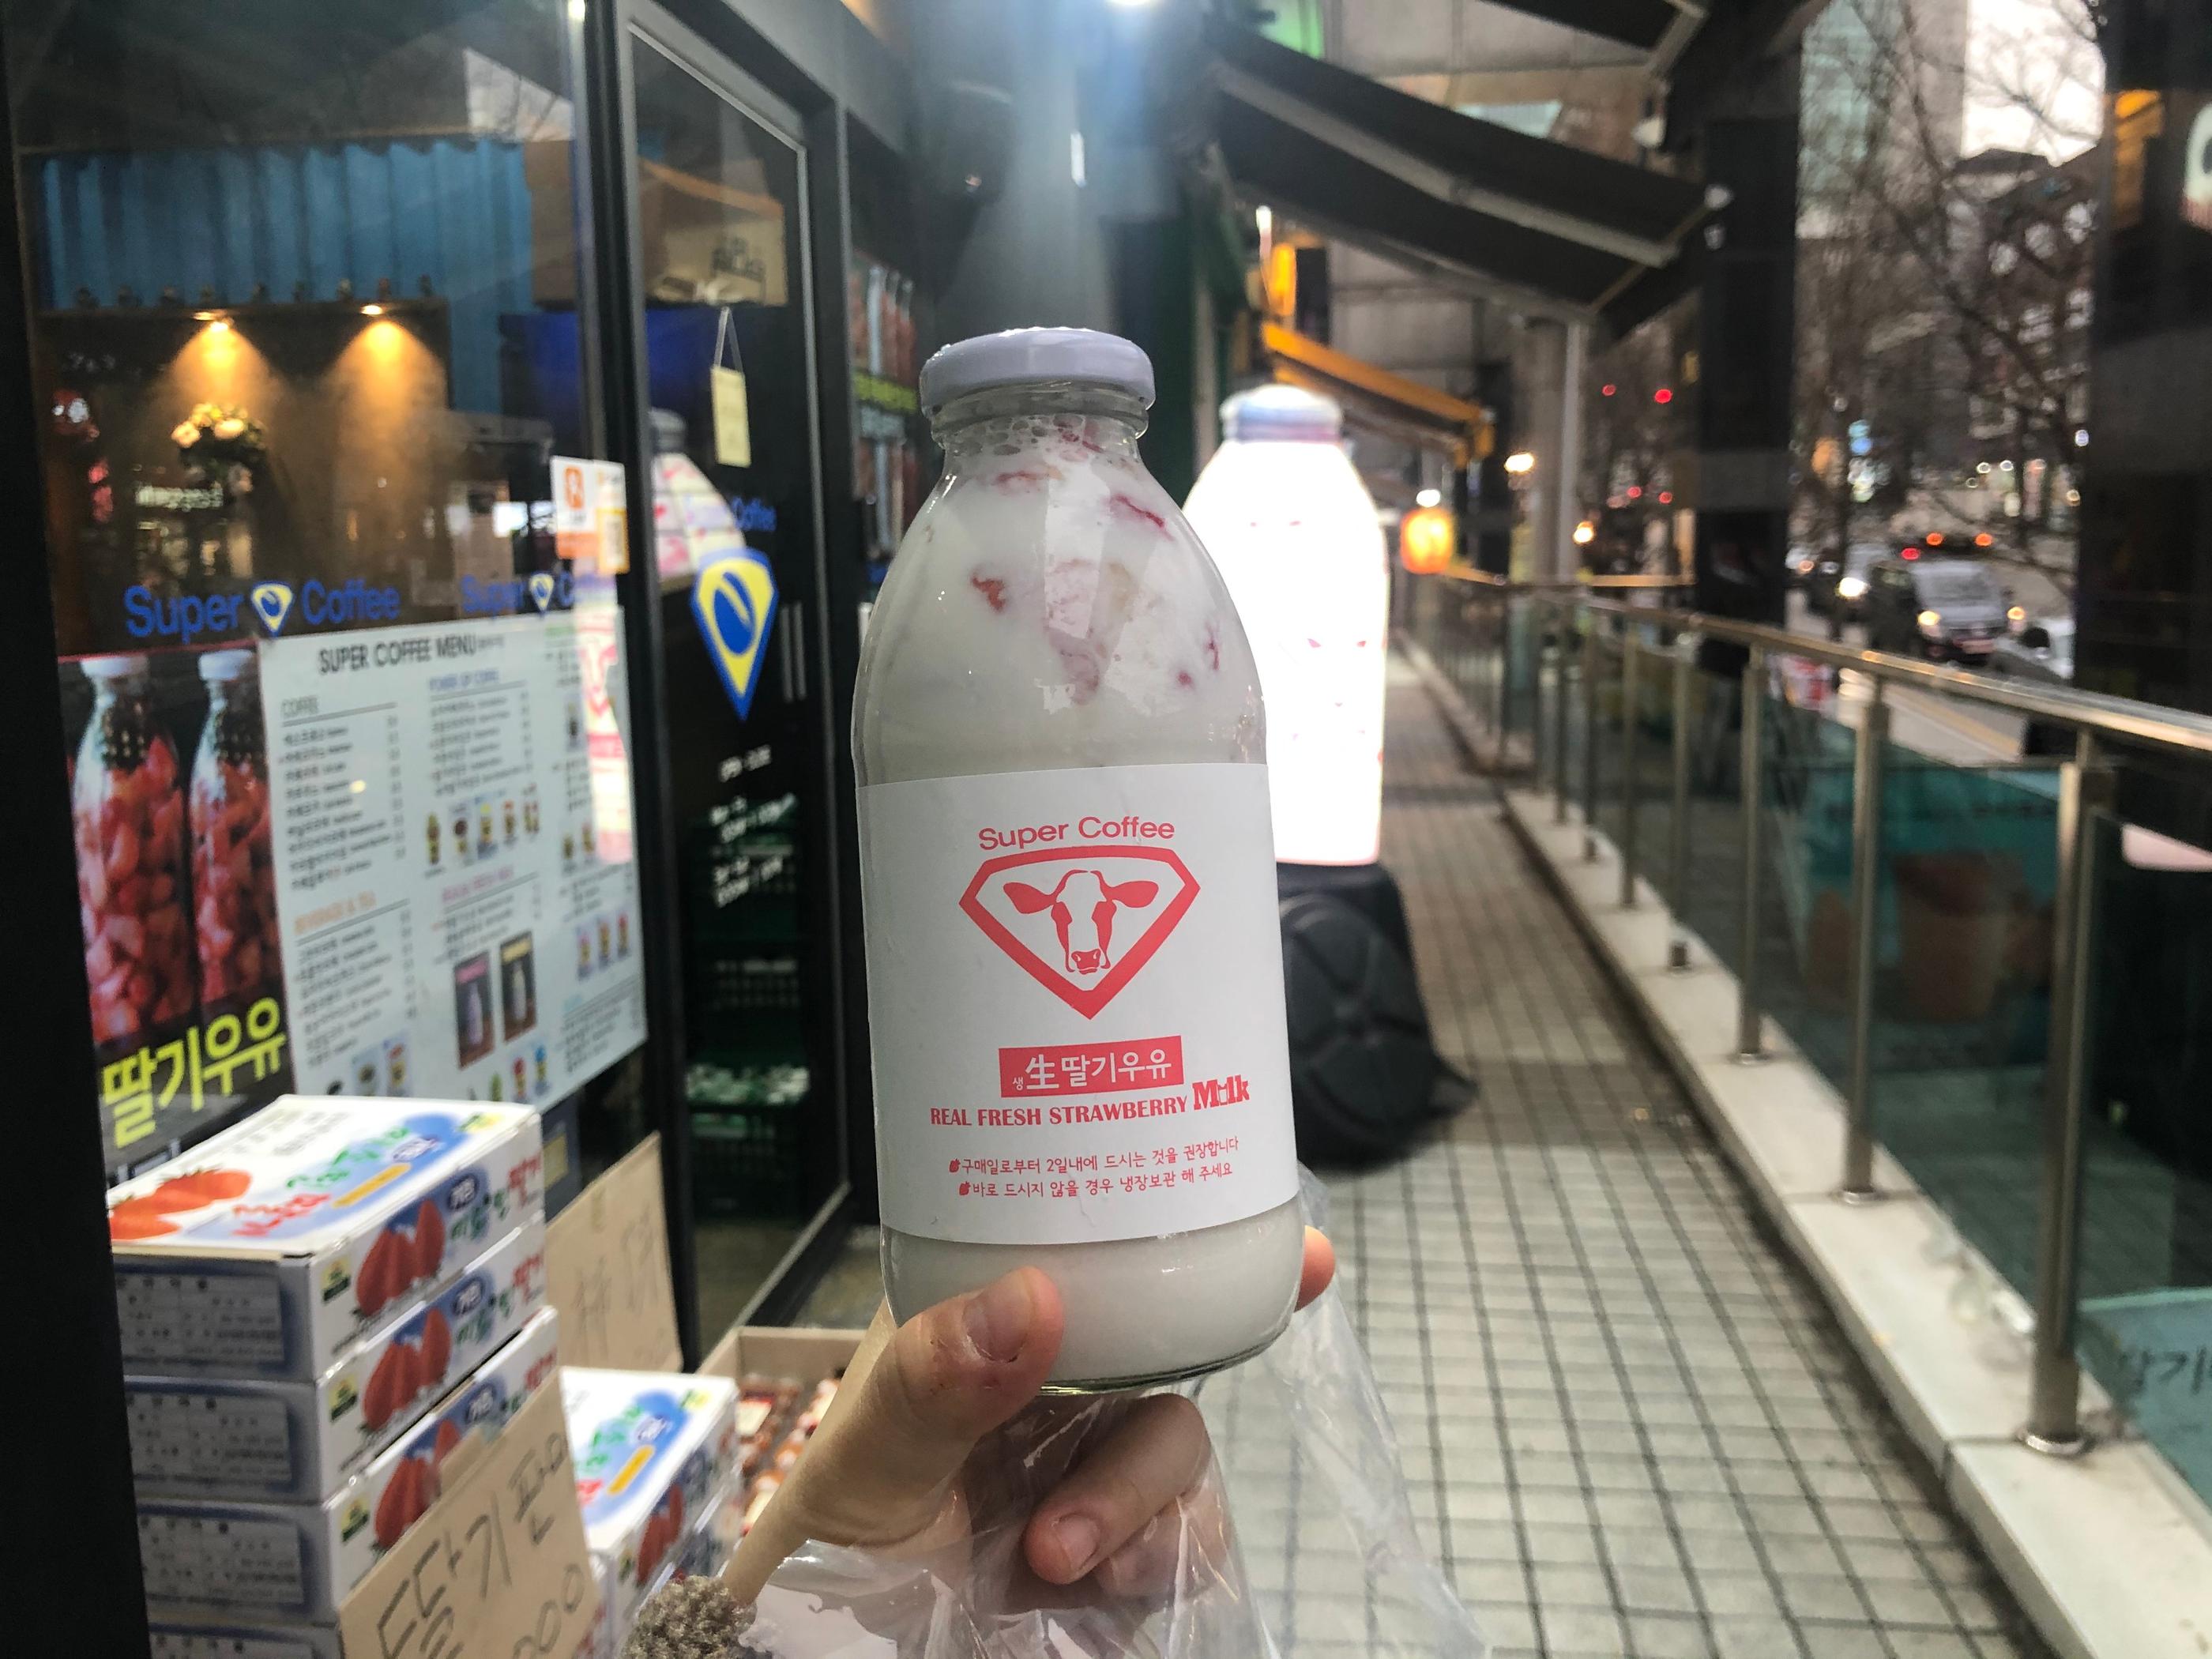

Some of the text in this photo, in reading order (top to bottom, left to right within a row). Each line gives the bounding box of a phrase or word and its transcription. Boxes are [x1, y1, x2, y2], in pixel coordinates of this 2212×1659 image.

[124, 579, 401, 645] Super Coffee
[318, 643, 368, 675] SUPER
[373, 638, 431, 667] COFFEE
[437, 633, 476, 659] MENU
[978, 816, 1175, 851] Super Coffee
[102, 996, 287, 1149] 딸기우유
[931, 1074, 1251, 1127] REAL FRESH STRAWBERRY Milk
[961, 1135, 1239, 1176] 구매일로부터 2일내에 드시는 것을 권장합니다
[972, 1162, 1233, 1198] 바로 드시지 않을 경우 냉장보관 해 주세요
